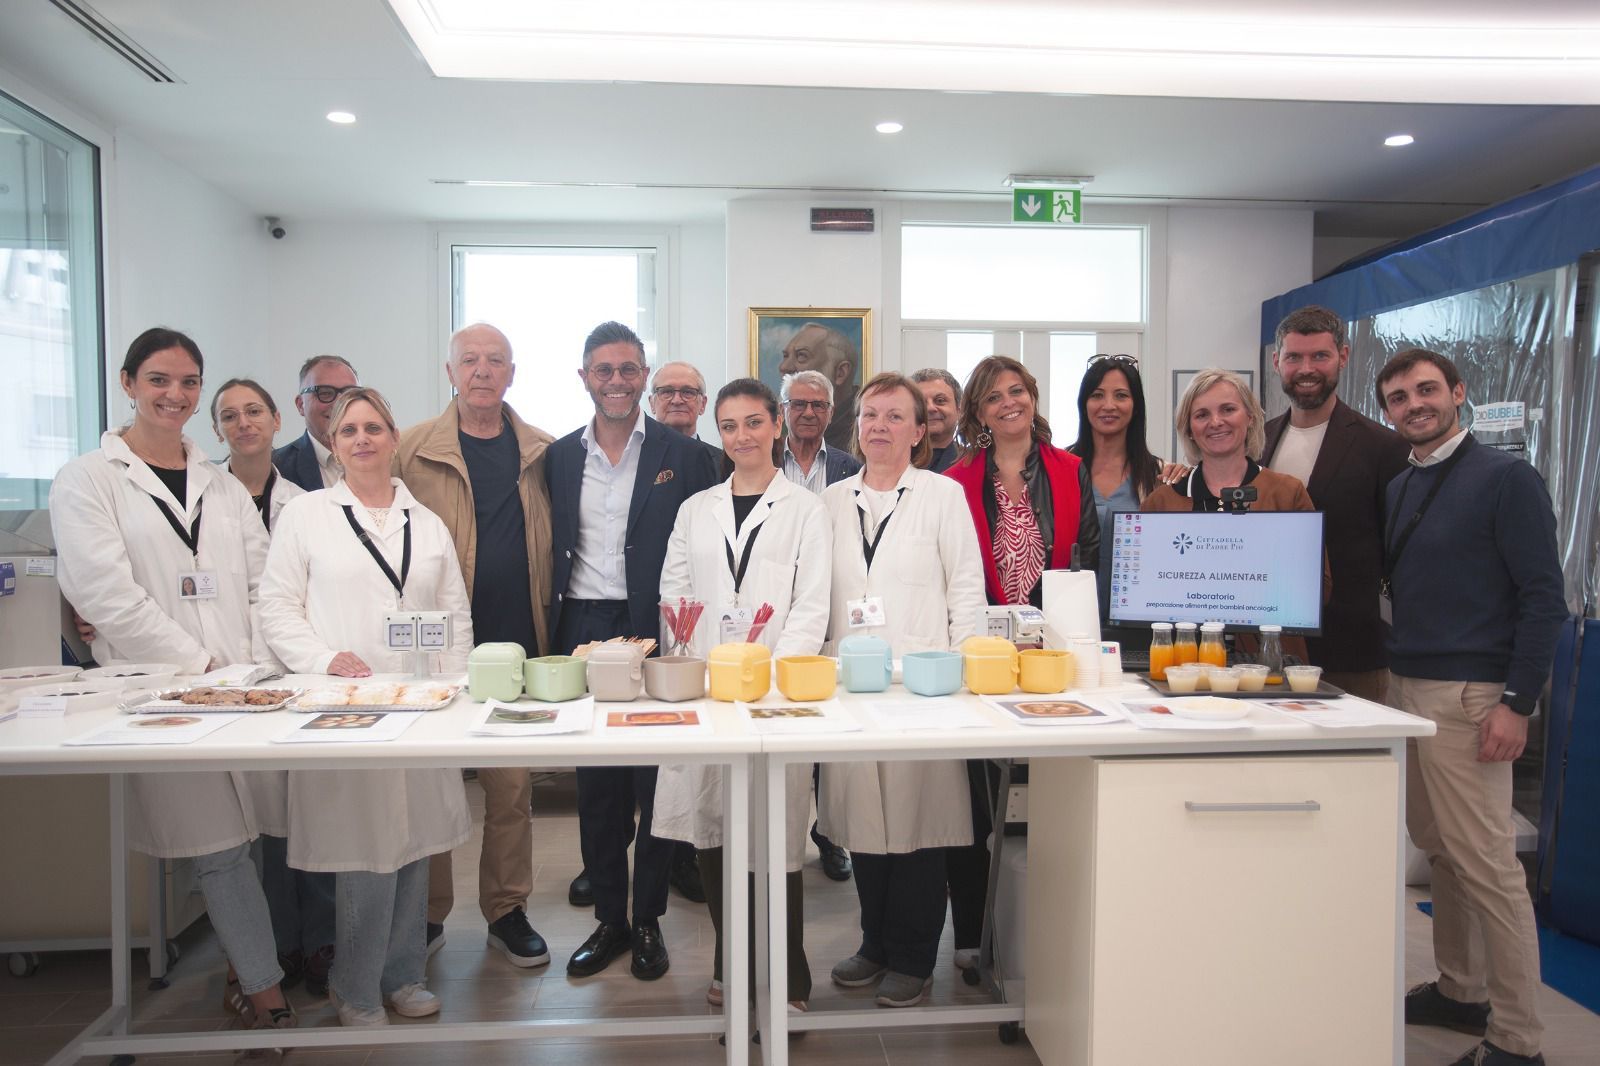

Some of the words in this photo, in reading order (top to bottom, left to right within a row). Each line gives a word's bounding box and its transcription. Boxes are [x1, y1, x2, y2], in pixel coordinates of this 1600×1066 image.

[1158, 571, 1206, 580] SICUREZZA
[1209, 572, 1268, 582] ALIMENTARE
[1187, 592, 1235, 600] Laboratorio
[1245, 604, 1278, 613] oncologici
